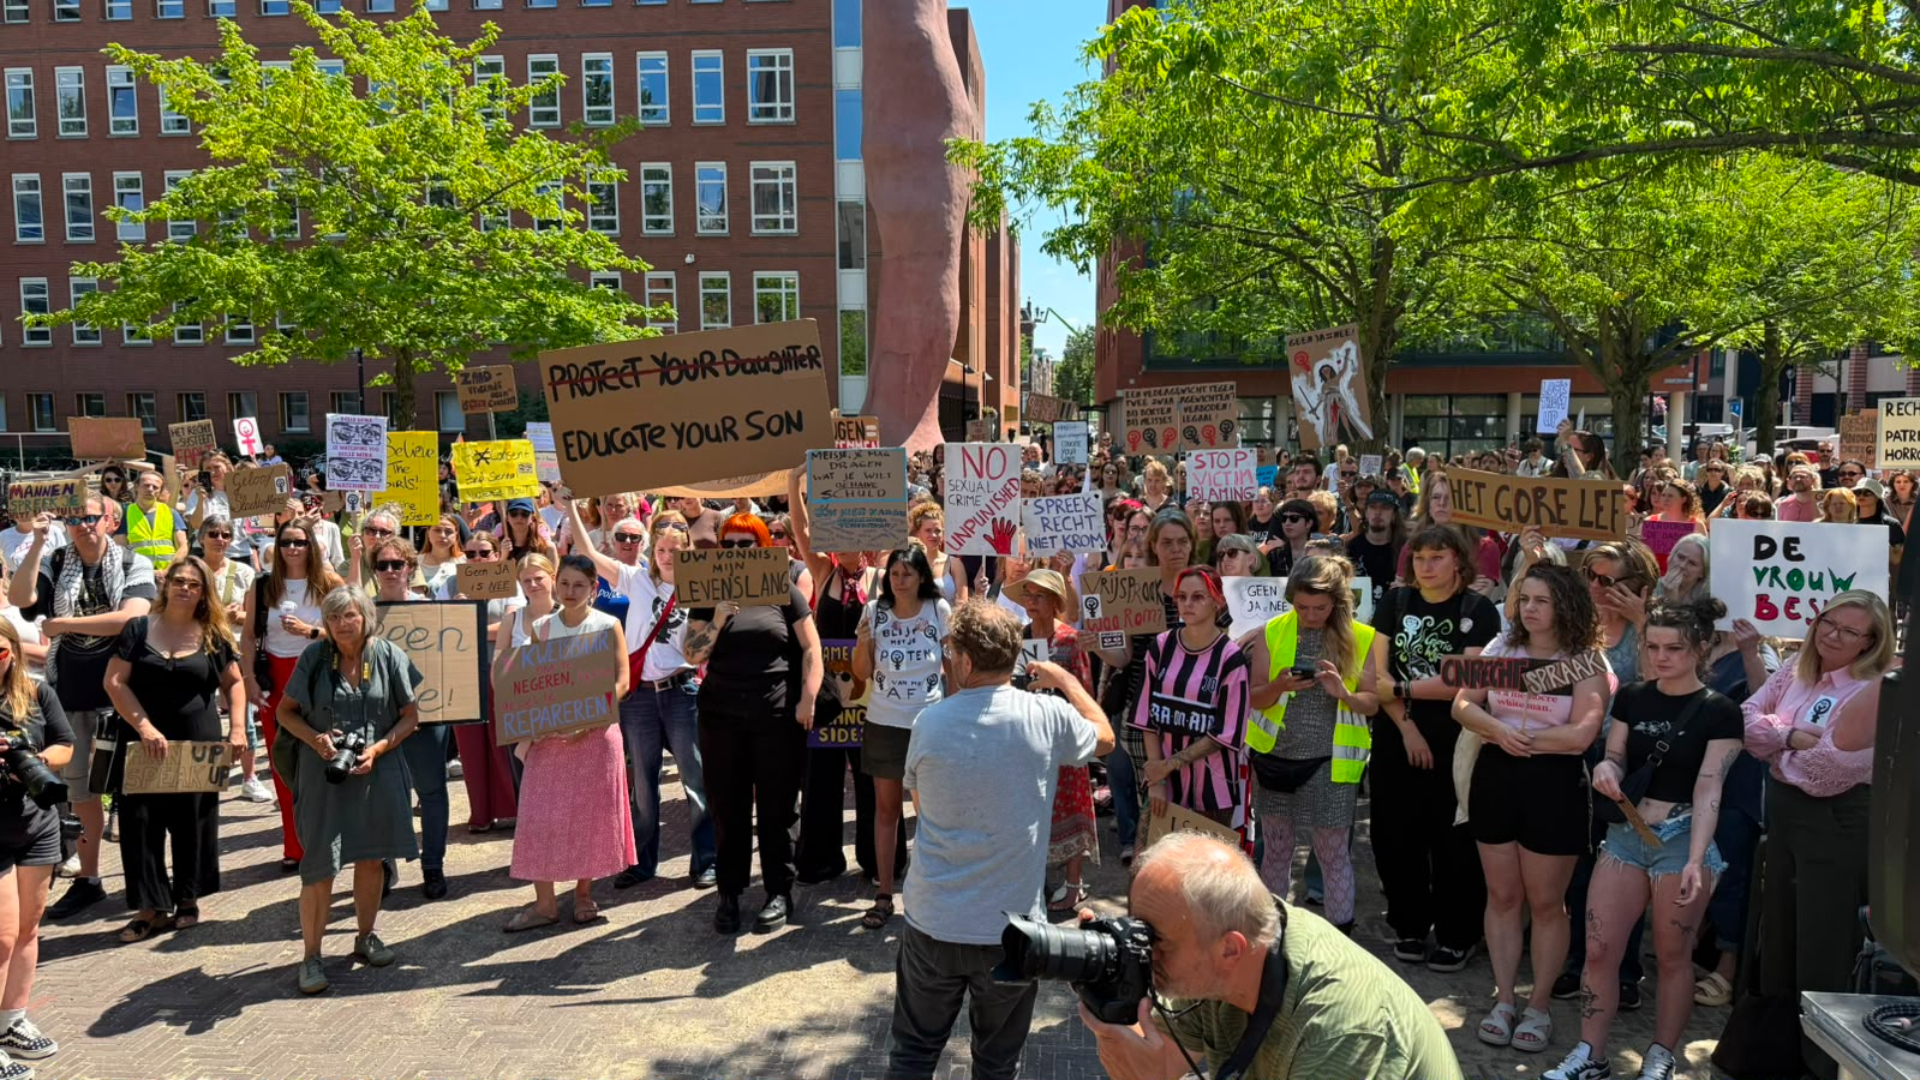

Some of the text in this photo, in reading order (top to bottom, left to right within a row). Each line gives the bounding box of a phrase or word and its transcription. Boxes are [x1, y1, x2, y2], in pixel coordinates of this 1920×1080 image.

[651, 350, 719, 386] YOUR
[745, 410, 803, 441] SON
[961, 446, 1008, 480] NO
[1194, 451, 1248, 469] STOP
[949, 480, 994, 493] SEXUAL
[1193, 469, 1254, 487] VICTIM
[10, 483, 75, 499] MANNEN
[1191, 486, 1256, 501] BLAMING
[948, 494, 981, 507] CRIME
[1034, 497, 1096, 515] SPREEK
[1449, 479, 1624, 534] HET GORE LEF
[1041, 515, 1096, 533] RECHT
[1028, 533, 1105, 550] NIET KROM
[1753, 535, 1805, 561] DE
[495, 564, 509, 576] JA
[712, 562, 744, 577] MIJN
[489, 580, 511, 592] NEE
[676, 571, 790, 604] LEVENSLANG
[1753, 566, 1857, 593] VROUW
[1247, 585, 1277, 597] GEEN
[1526, 651, 1606, 694] SPRAAK
[513, 671, 574, 695] NEGEREN,
[192, 745, 225, 763] UP
[125, 765, 230, 790] SPEAK UP
